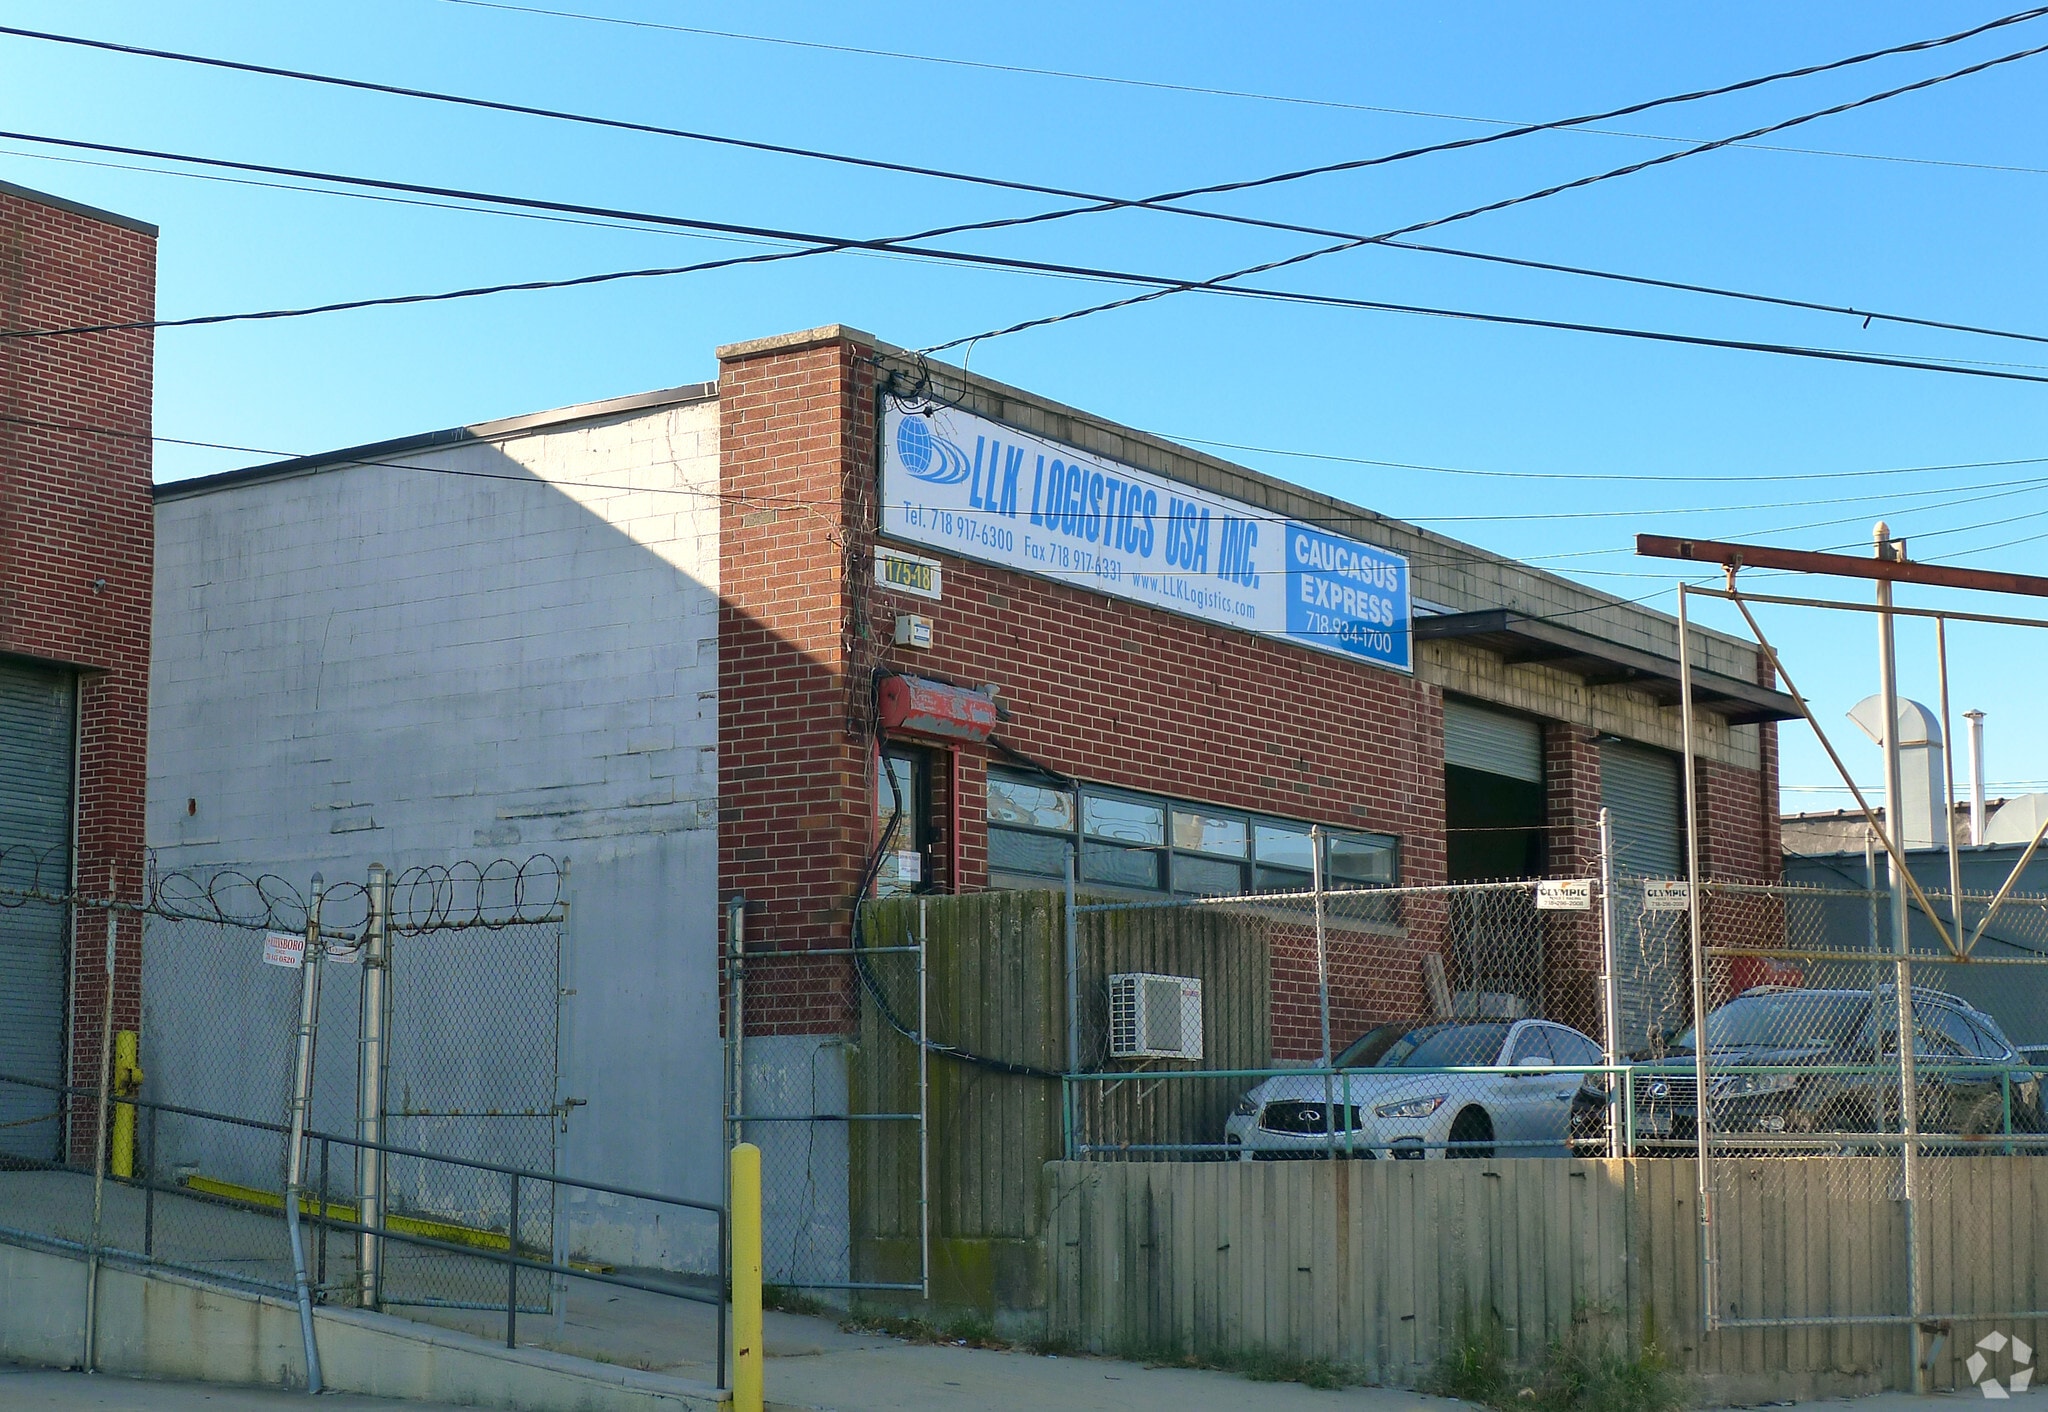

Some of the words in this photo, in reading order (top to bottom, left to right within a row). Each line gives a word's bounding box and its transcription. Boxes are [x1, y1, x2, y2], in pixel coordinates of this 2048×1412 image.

[969, 435, 1024, 520] LLK
[1030, 454, 1157, 558] LOGISTICS
[1165, 496, 1210, 574] USA
[1217, 513, 1260, 590] INC.
[885, 556, 931, 590] 175-18
[903, 500, 926, 529] Tel.
[931, 509, 953, 535] 718
[957, 516, 1013, 552] 917-6300
[1024, 535, 1046, 561] Fax
[1049, 542, 1069, 568] 718
[1073, 549, 1121, 582] 917-6331
[1132, 572, 1255, 619] www.LLKLogistics.com
[1294, 534, 1398, 592] CAUCASUS
[1301, 572, 1393, 627] EXPRESS
[1540, 888, 1588, 897] OLYMPIC
[1647, 889, 1688, 897] OLYMPIC
